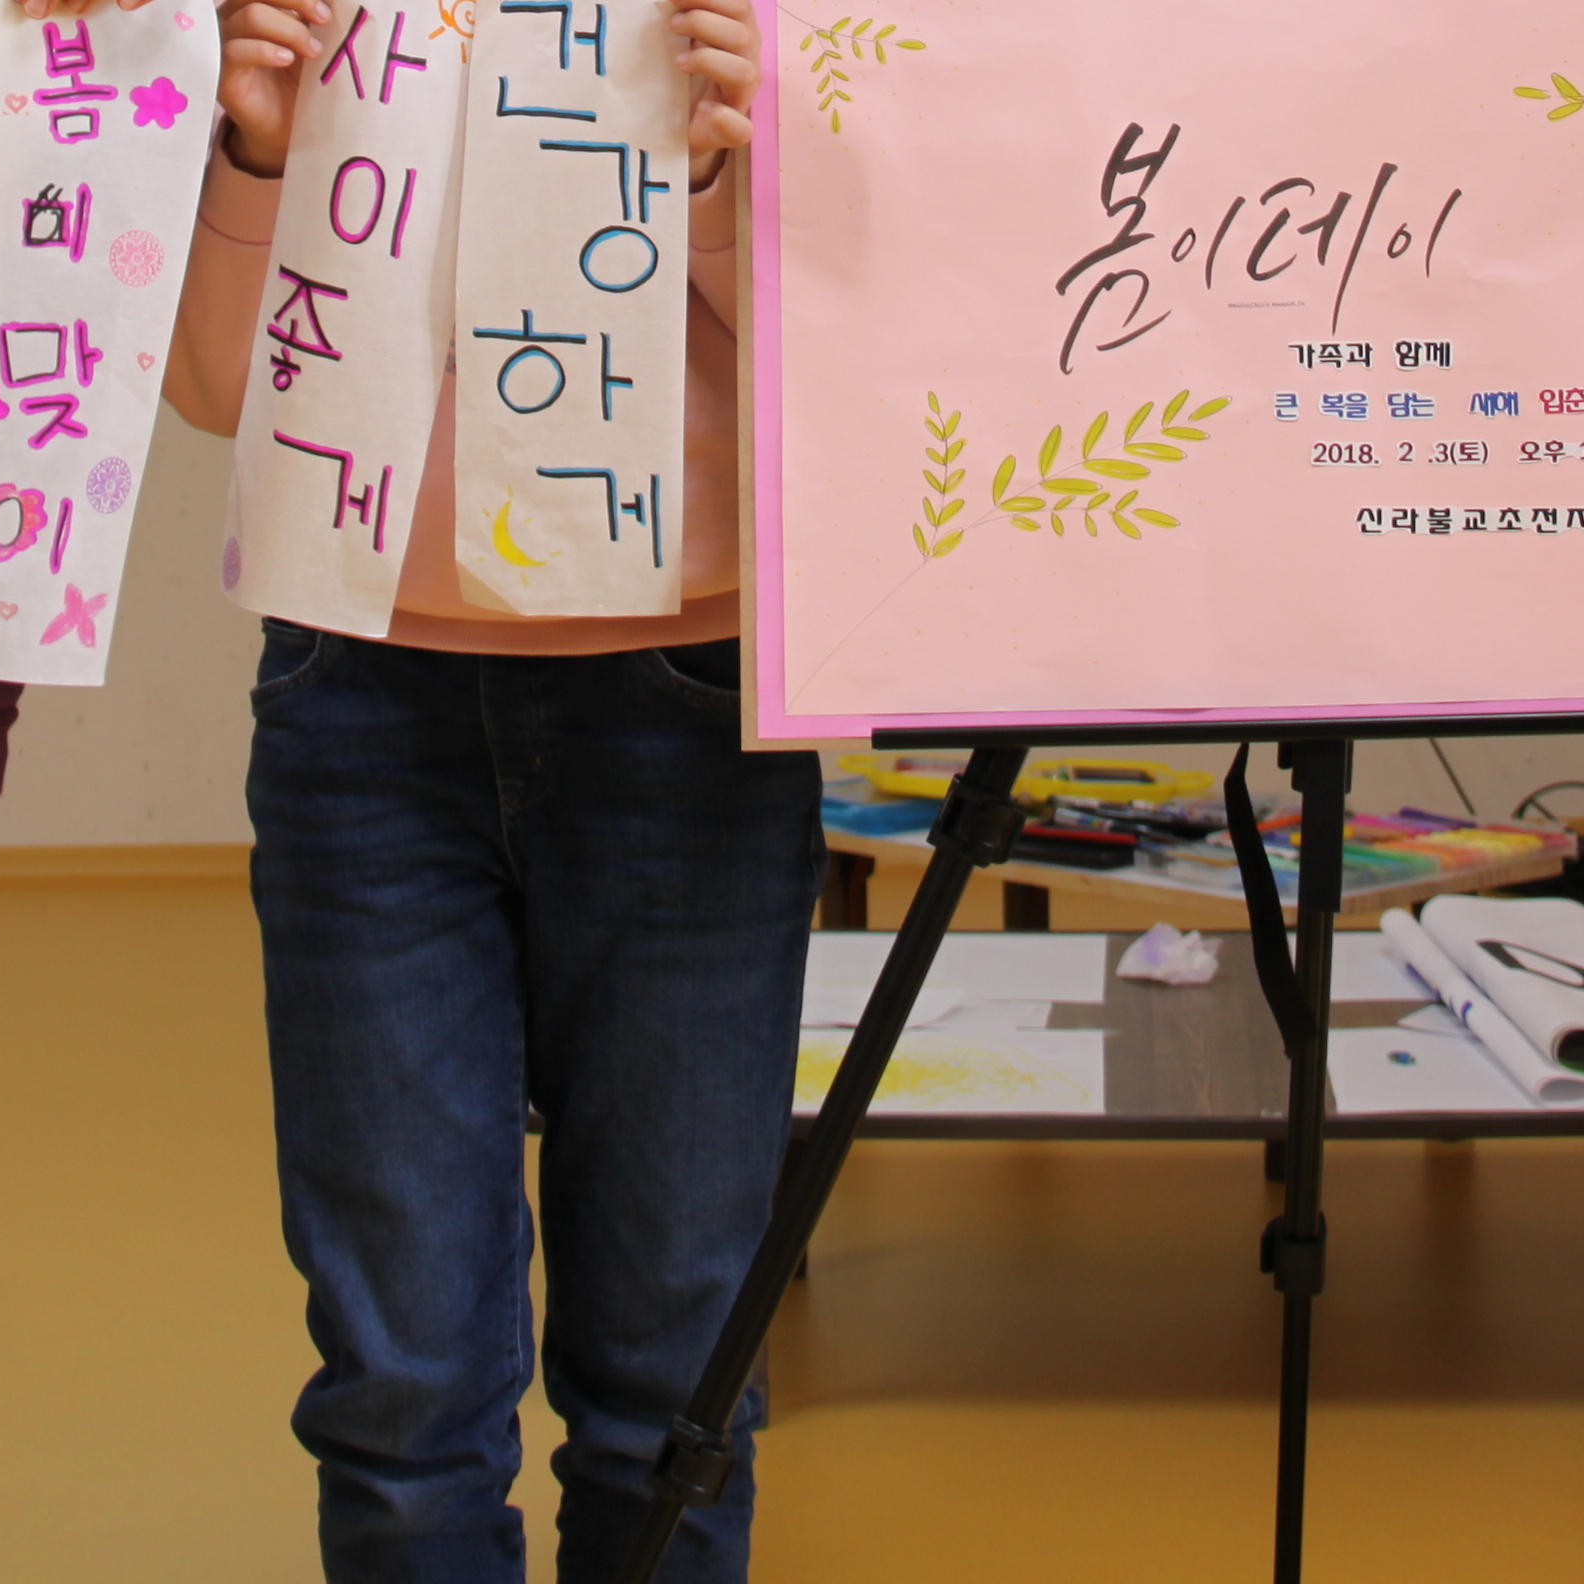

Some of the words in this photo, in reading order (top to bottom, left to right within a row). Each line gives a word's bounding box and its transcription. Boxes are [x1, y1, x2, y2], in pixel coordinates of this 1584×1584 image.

[266, 4, 428, 554] 사이좋게
[472, 0, 671, 569] 건강하게
[1055, 121, 1462, 375] 봄이데이
[1274, 392, 1299, 418] 큰
[1320, 392, 1369, 419] 복을
[1386, 392, 1435, 419] 담는
[1469, 390, 1520, 417] 새해
[1288, 341, 1374, 370] 가족과
[1394, 339, 1451, 369] 함께
[1312, 441, 1380, 465] 2018.
[1518, 439, 1567, 464] 오후
